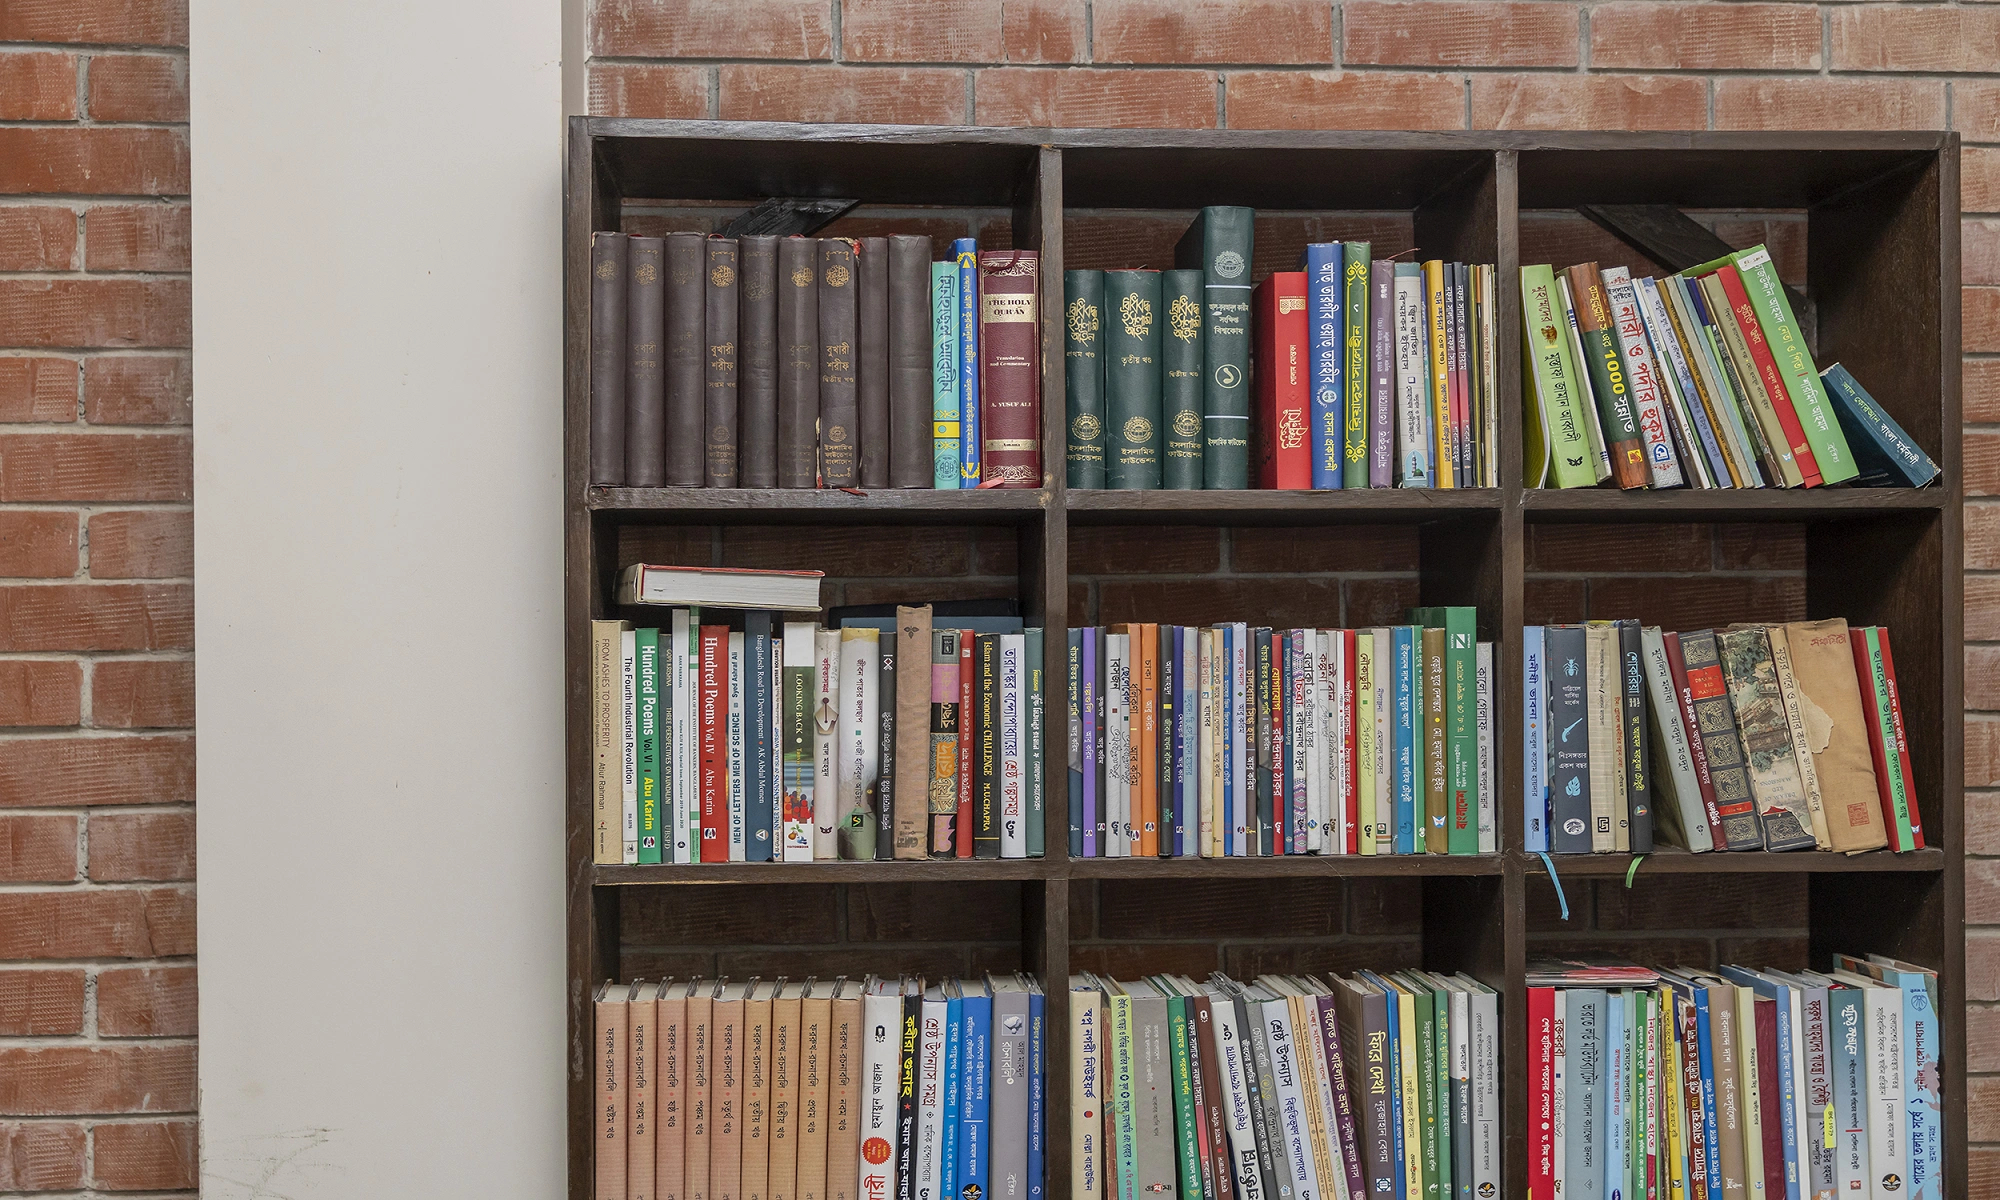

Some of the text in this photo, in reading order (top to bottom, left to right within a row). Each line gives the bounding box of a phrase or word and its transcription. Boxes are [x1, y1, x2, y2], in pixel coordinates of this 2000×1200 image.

[936, 275, 957, 393] মিনহাজুল আবেদীন
[1213, 325, 1245, 336] বিশ্বকোষ
[1398, 290, 1409, 369] বিস্ময়কর ইতিহাস
[1408, 304, 1418, 355] জ্বিন জাতির
[711, 342, 734, 357] বুখারী
[711, 357, 733, 371] শরীফ
[825, 341, 850, 357] বুখারী
[825, 357, 849, 371] শরীফ
[1120, 355, 1153, 367] তৃতীয় খণ্ড
[1532, 284, 1580, 442] মুহাম্মদের মুস্তাফা জামান আব্বাসী
[1769, 297, 1786, 323] আহমদ
[1778, 325, 1792, 343] নেতা
[1789, 352, 1804, 371] পিতা
[1801, 377, 1817, 405] শারমিন
[1812, 405, 1828, 430] আহমদ
[1349, 325, 1362, 432] রিয়াদুস সালেহীন
[1604, 350, 1636, 433] 1000 সুন্নাত
[1619, 305, 1666, 444] নারী ও পর্দার হুকুম
[1323, 411, 1334, 436] হাসনা
[1119, 456, 1157, 466] ফাউন্ডেশন
[1120, 446, 1156, 457] ইসলামিক
[1324, 438, 1337, 471] প্রকাশনী
[601, 638, 609, 661] FROM
[756, 633, 765, 669] Bangladesh
[984, 641, 993, 661] Islam
[601, 662, 609, 687] ASHES
[984, 663, 993, 677] and
[984, 678, 993, 691] the
[1528, 653, 1538, 684] মনীষী
[601, 690, 609, 700] TO
[731, 683, 739, 697] Syed
[757, 688, 764, 697] To
[795, 674, 803, 733] LOOKING BACK
[1529, 687, 1537, 719] ভাবনা
[1775, 646, 1806, 749] মৃত্যুর পরে ও আত্মার কথা
[601, 702, 610, 748] PROSPERITY
[624, 656, 633, 784] The Fourth Industrial Revolution
[704, 637, 717, 815] Hundred Poems Vol. IV Abu Karim
[756, 698, 764, 738] Development
[984, 693, 993, 728] Economic
[642, 645, 656, 829] Hundred Poems Vol. VI Abu Karim
[732, 712, 740, 745] SCIENCE
[1003, 648, 1023, 816] তারাশঙ্কর বন্দ্যোপাধ্যায়ের শ্রেষ্ঠ গল্পসমগ্র
[732, 747, 740, 757] OF
[732, 760, 740, 776] MEN
[758, 746, 765, 758] AK
[984, 730, 993, 776] CHALLENGE
[665, 766, 672, 775] ON
[598, 780, 606, 809] Rahman
[732, 778, 740, 812] LETTERS
[733, 815, 740, 824] OF
[1001, 1041, 1016, 1079] রচনাবলি
[1270, 1019, 1292, 1086] শ্রেষ্ঠ উপন্যাস
[1323, 1008, 1349, 1114] বিলেত ও থাইল্যান্ড ভ্রমণ
[1540, 1017, 1551, 1119] শেখ হাসিনার পতনের নেপথ্যে
[1720, 1010, 1736, 1129] জীবনানন্দ দাশ সূর্য-অসূর্যলোক
[776, 1025, 788, 1138] ফররুখ-রচনাবলি দ্বিতীয় খণ্ড
[1080, 1007, 1096, 1190] স্বপ্ন নগরী নিউইয়র্ক মোল্লা বাহাউদ্দিন
[1368, 1030, 1388, 1162] ফিরে দেখা নূরজাহান বেগম
[921, 1018, 943, 1181] শ্রেষ্ঠ উপন্যাস সমগ্র মানিক বন্দ্যোপাধ্যায়
